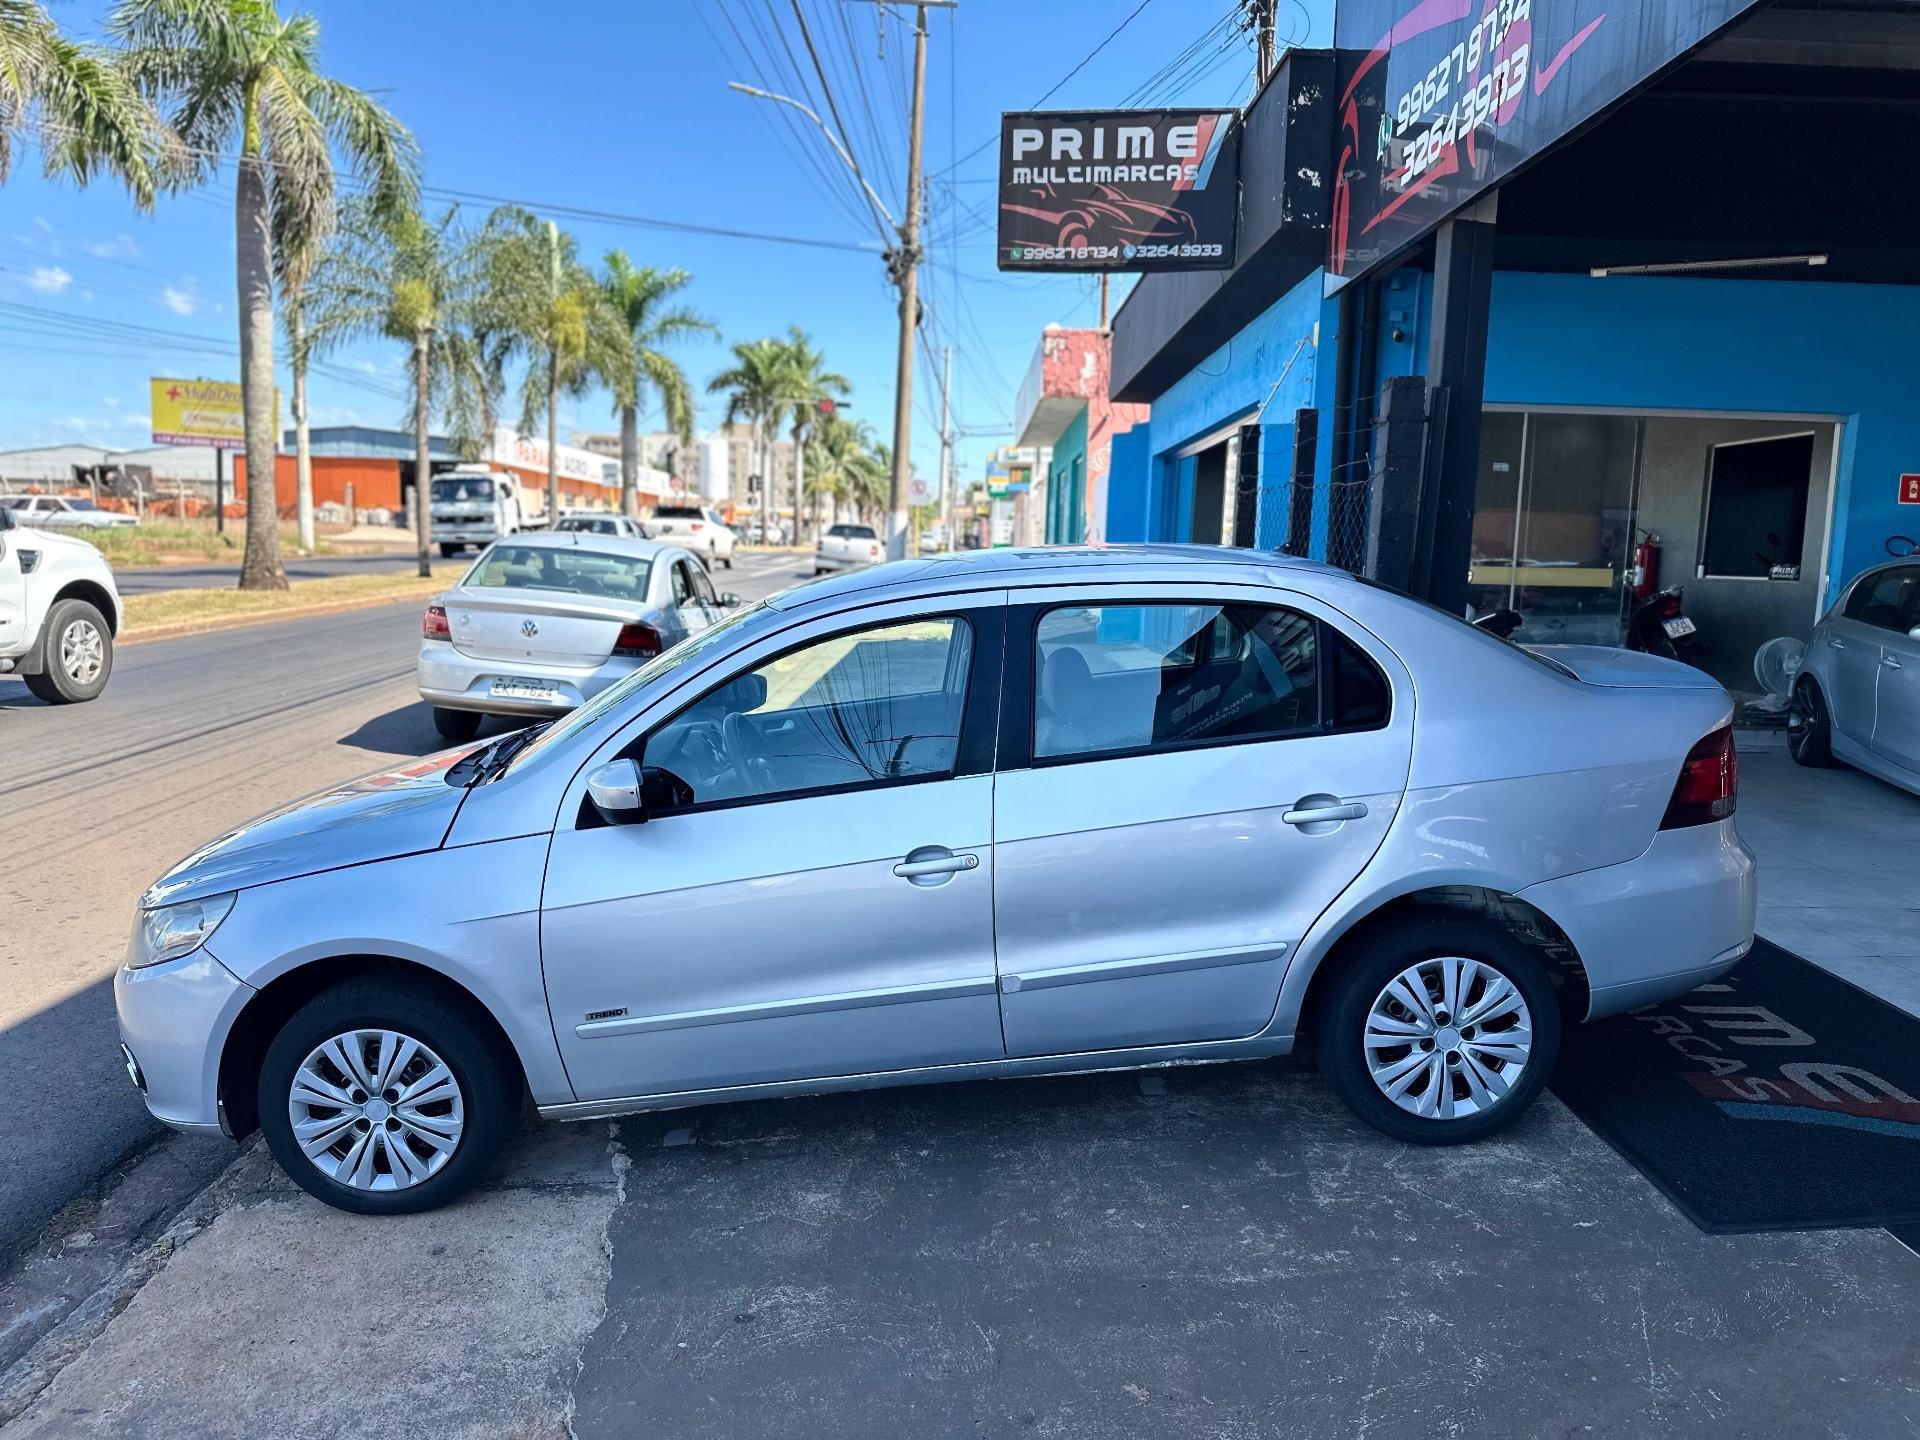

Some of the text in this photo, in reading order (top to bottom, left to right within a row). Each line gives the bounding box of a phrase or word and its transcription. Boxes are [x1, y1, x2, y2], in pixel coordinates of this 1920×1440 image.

[1012, 125, 1198, 161] PRIME
[1012, 164, 1200, 184] MULTIMARCAS
[494, 683, 518, 695] EKT
[588, 1008, 624, 1019] TREND
